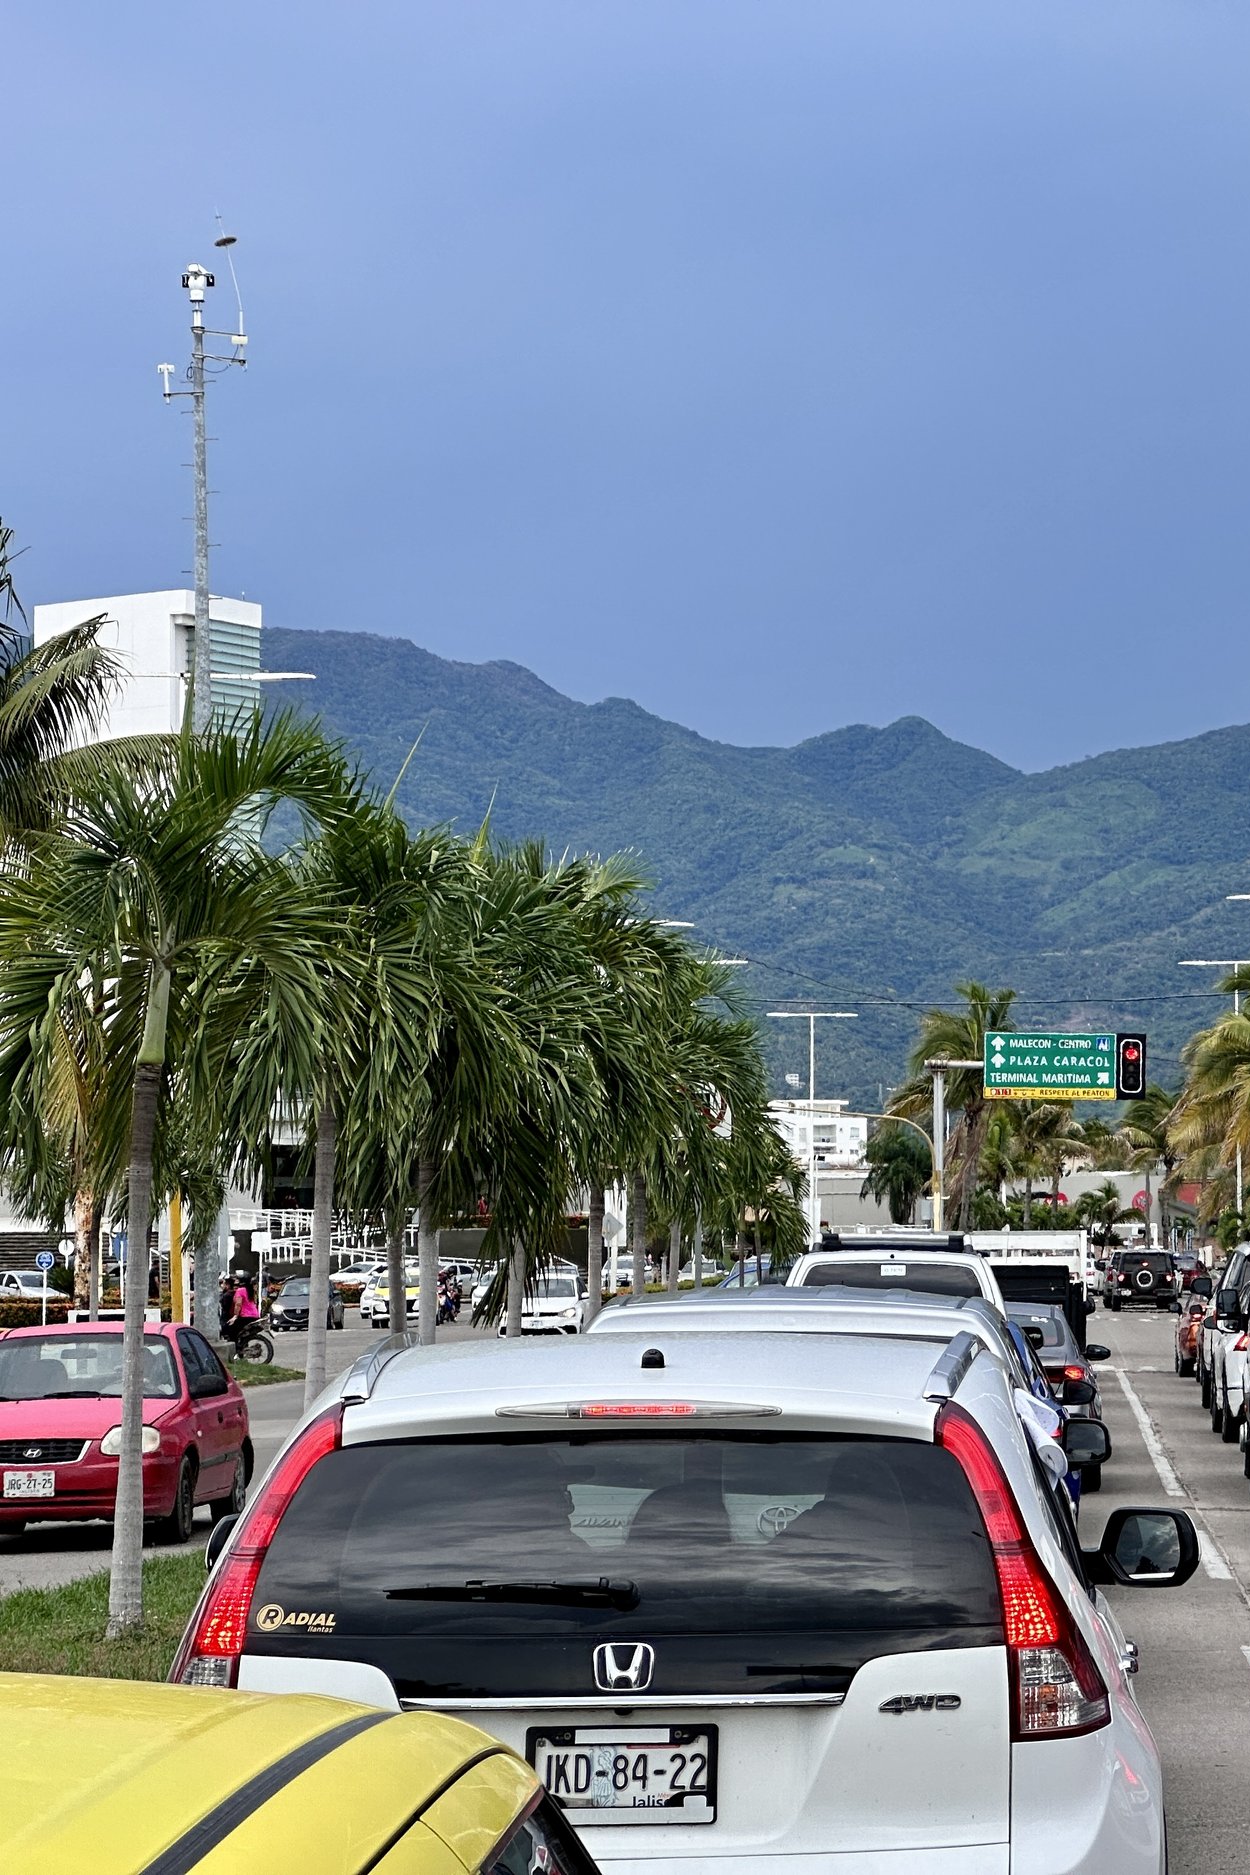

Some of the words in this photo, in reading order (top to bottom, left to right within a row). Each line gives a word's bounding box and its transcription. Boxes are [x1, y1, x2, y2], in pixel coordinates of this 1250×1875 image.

[1009, 1039, 1051, 1049] MALECON
[1058, 1039, 1092, 1049] CENTRO
[1009, 1057, 1048, 1066] PLAZA
[1053, 1056, 1110, 1067] CARACOL
[990, 1072, 1038, 1083] TERMINAL
[1042, 1073, 1091, 1083] MARITIMA
[1039, 1088, 1069, 1096] RESPETE
[1071, 1088, 1081, 1097] AL
[1082, 1089, 1110, 1097] PEATON
[6, 1478, 53, 1490] JRG-27-25
[258, 1605, 336, 1630] RADIAL
[878, 1694, 962, 1715] 4WD
